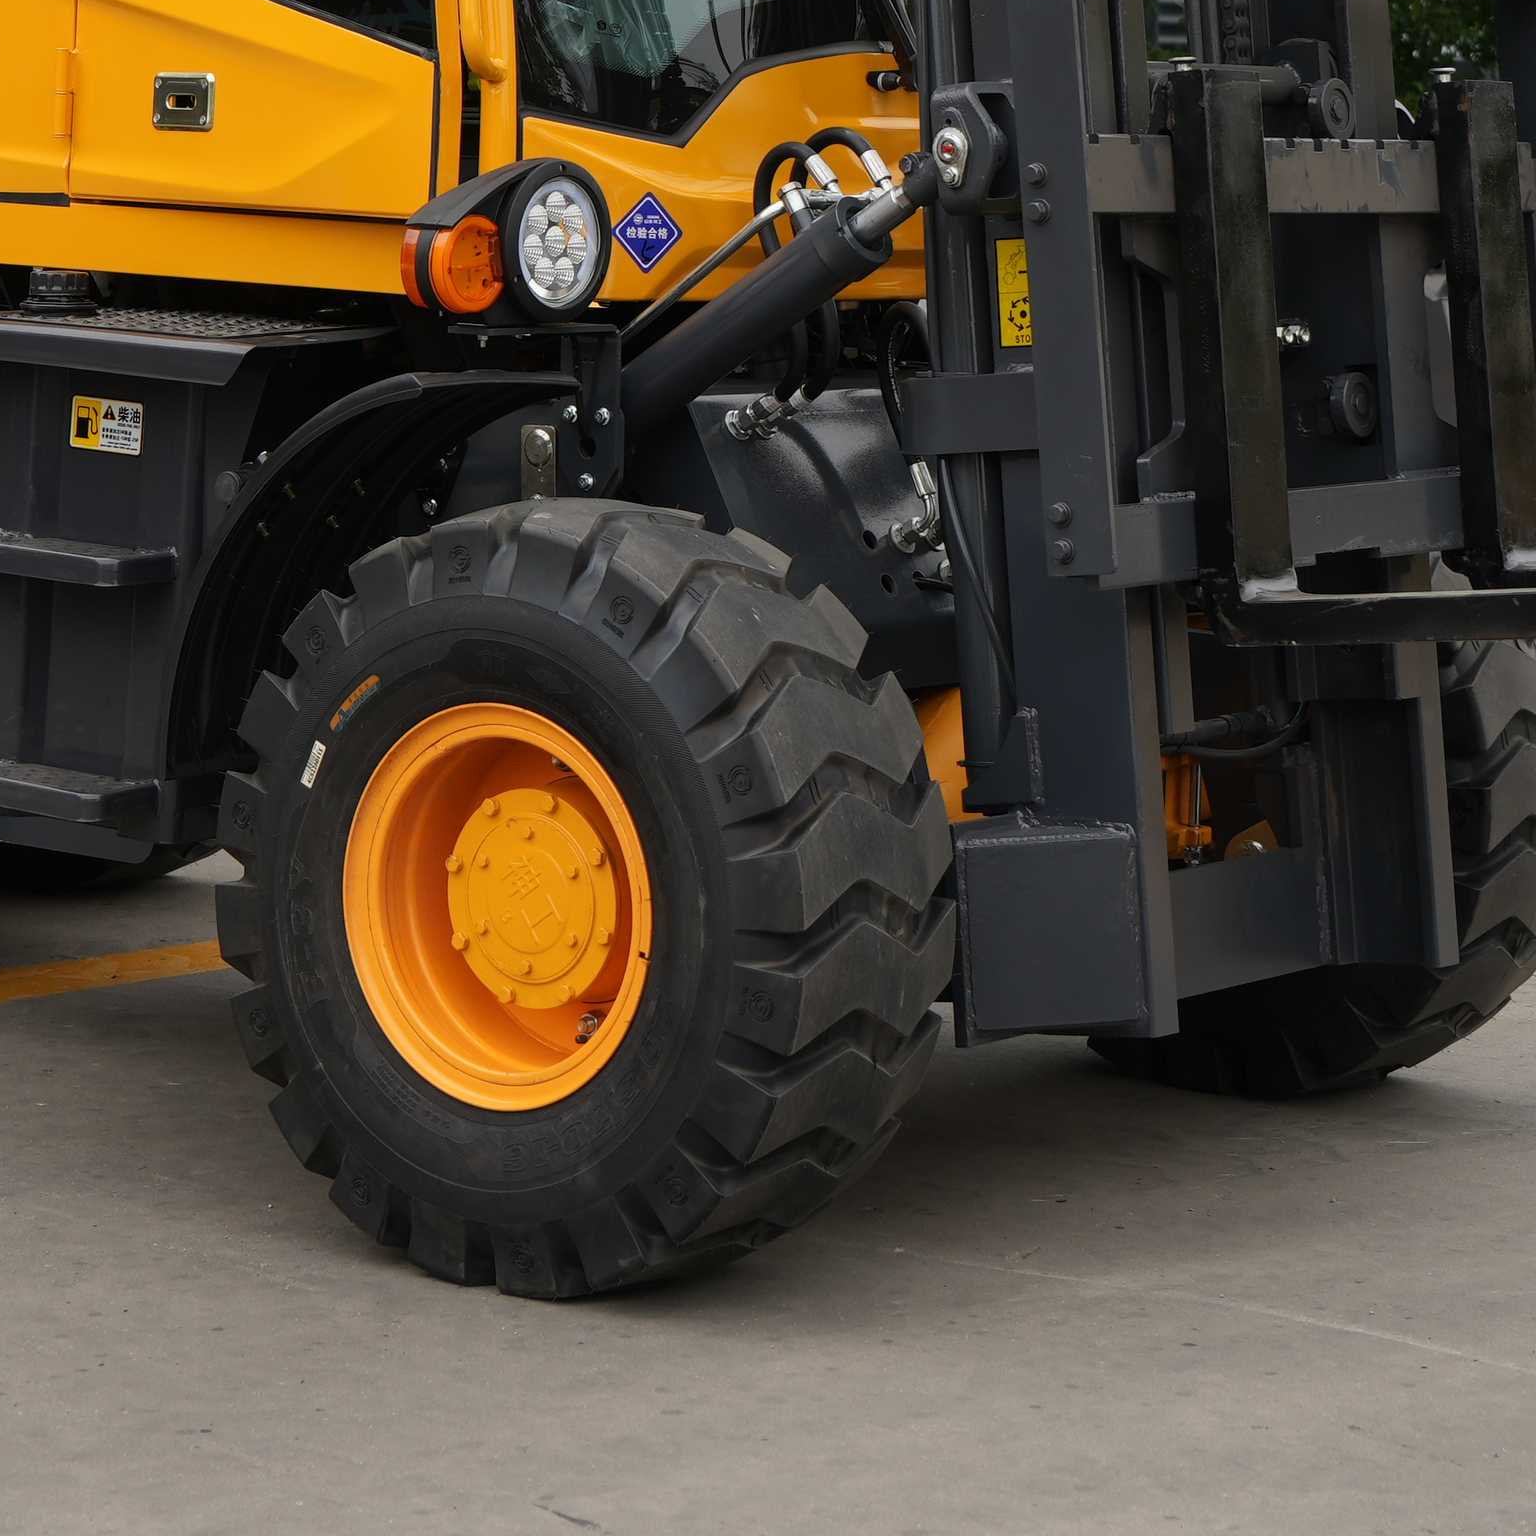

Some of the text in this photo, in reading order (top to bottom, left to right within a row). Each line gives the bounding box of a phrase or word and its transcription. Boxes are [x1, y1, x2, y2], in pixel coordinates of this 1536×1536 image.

[625, 226, 669, 240] 检验合格
[1015, 335, 1032, 344] STO
[117, 405, 141, 425] 柴油
